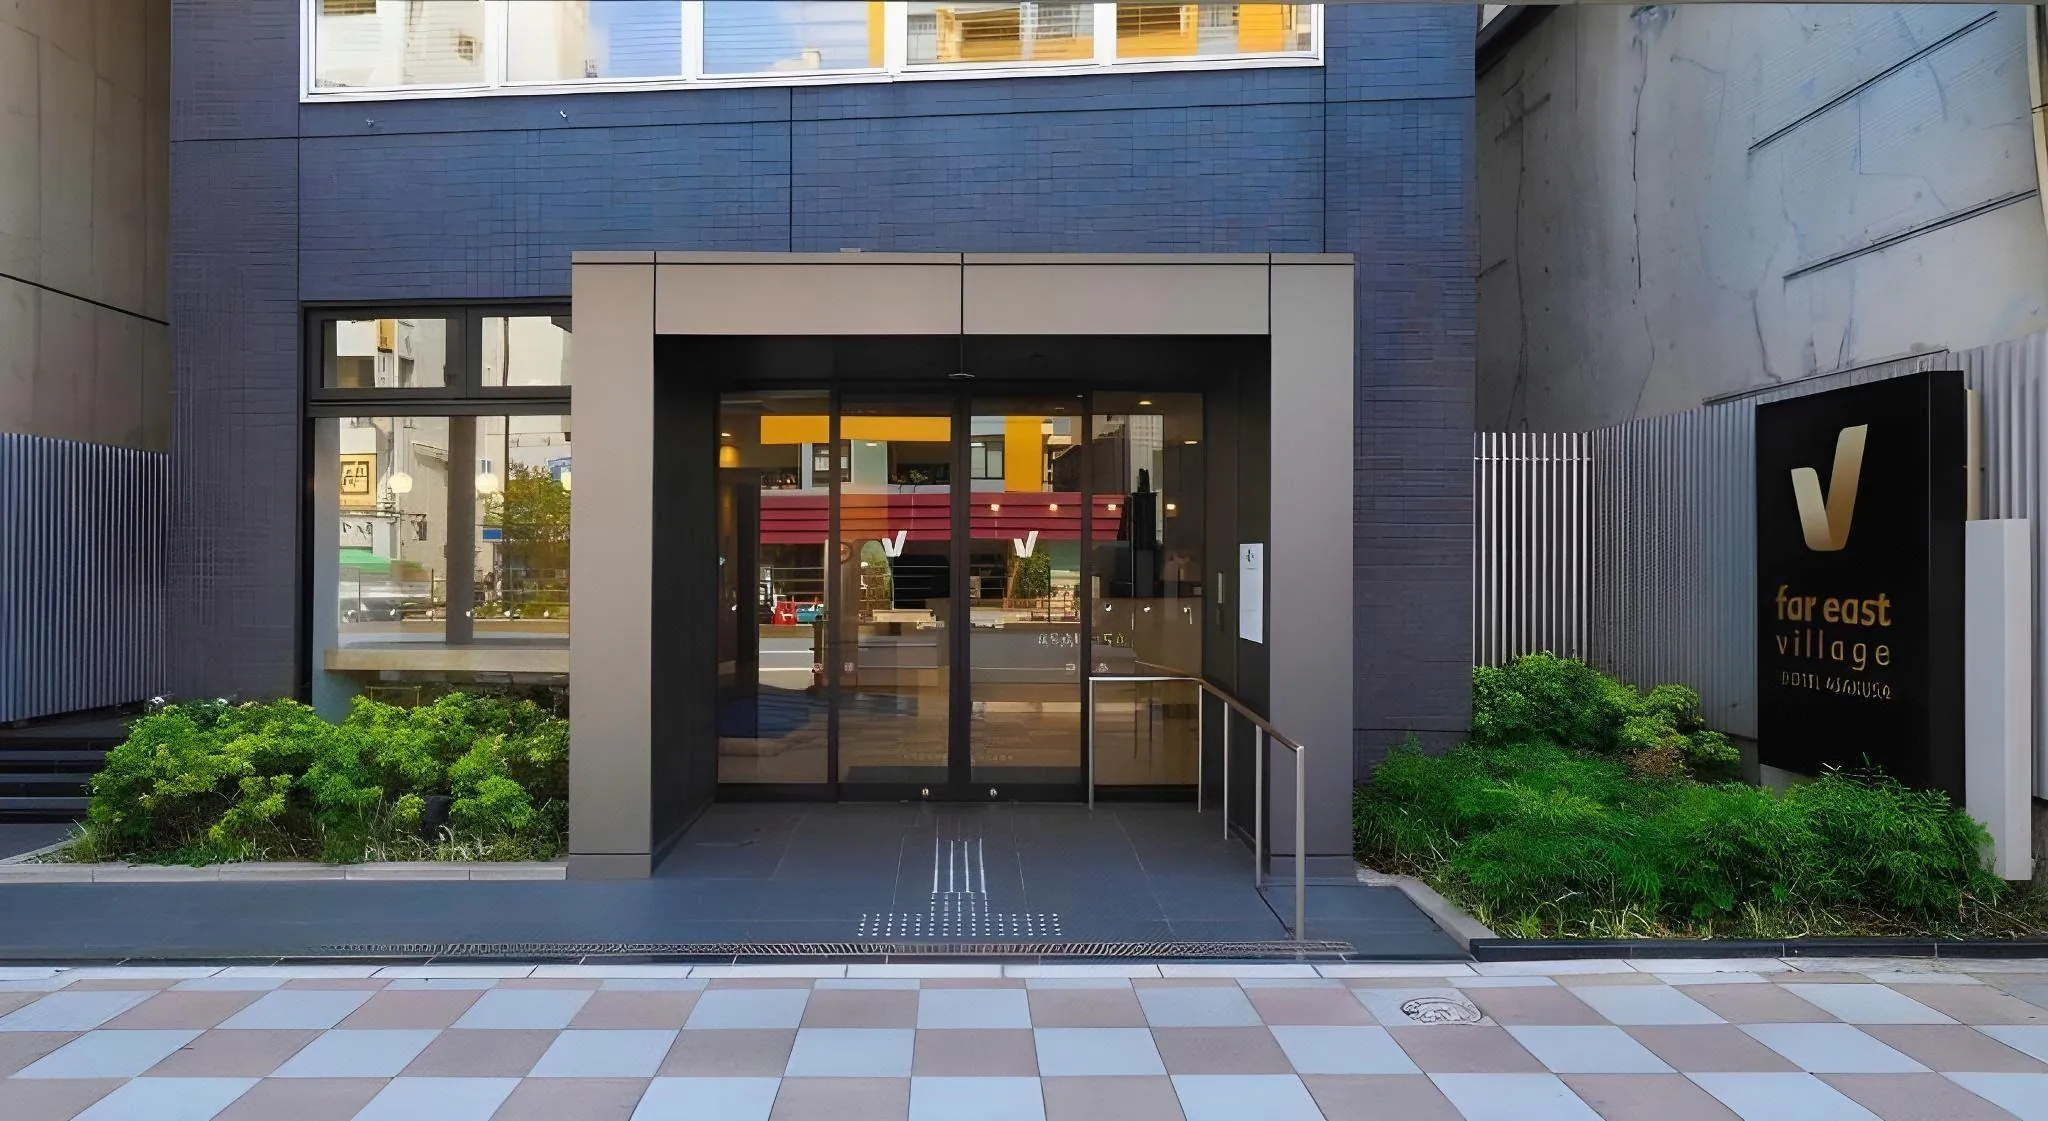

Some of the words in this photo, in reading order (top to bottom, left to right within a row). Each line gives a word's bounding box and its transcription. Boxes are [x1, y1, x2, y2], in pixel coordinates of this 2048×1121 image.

[1776, 584, 1817, 622] far
[1823, 592, 1892, 627] east
[1776, 628, 1891, 671] village
